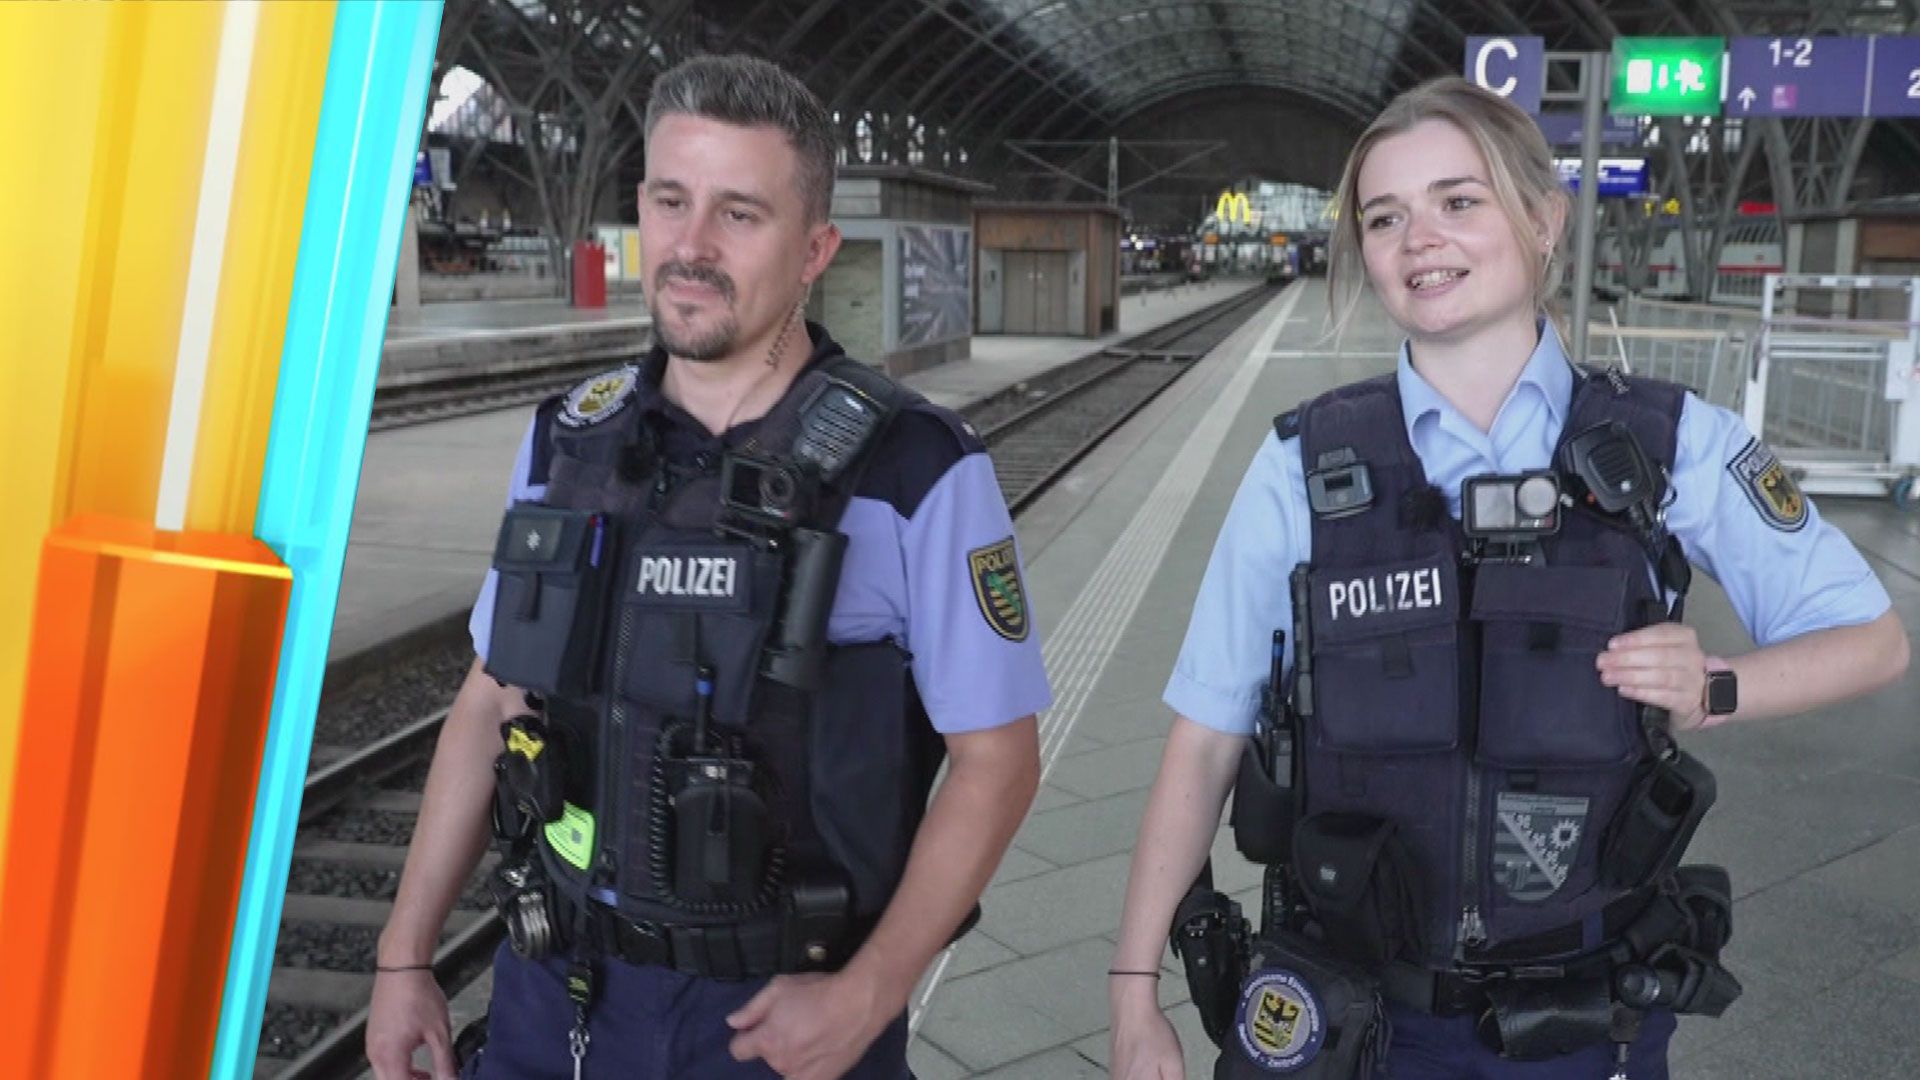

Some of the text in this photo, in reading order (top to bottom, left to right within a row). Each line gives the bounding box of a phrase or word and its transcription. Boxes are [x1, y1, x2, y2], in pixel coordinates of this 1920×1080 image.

[1475, 38, 1518, 97] C
[1769, 38, 1813, 67] 1-2
[637, 556, 737, 597] POLIZEI
[1329, 567, 1442, 620] POLIZEI
